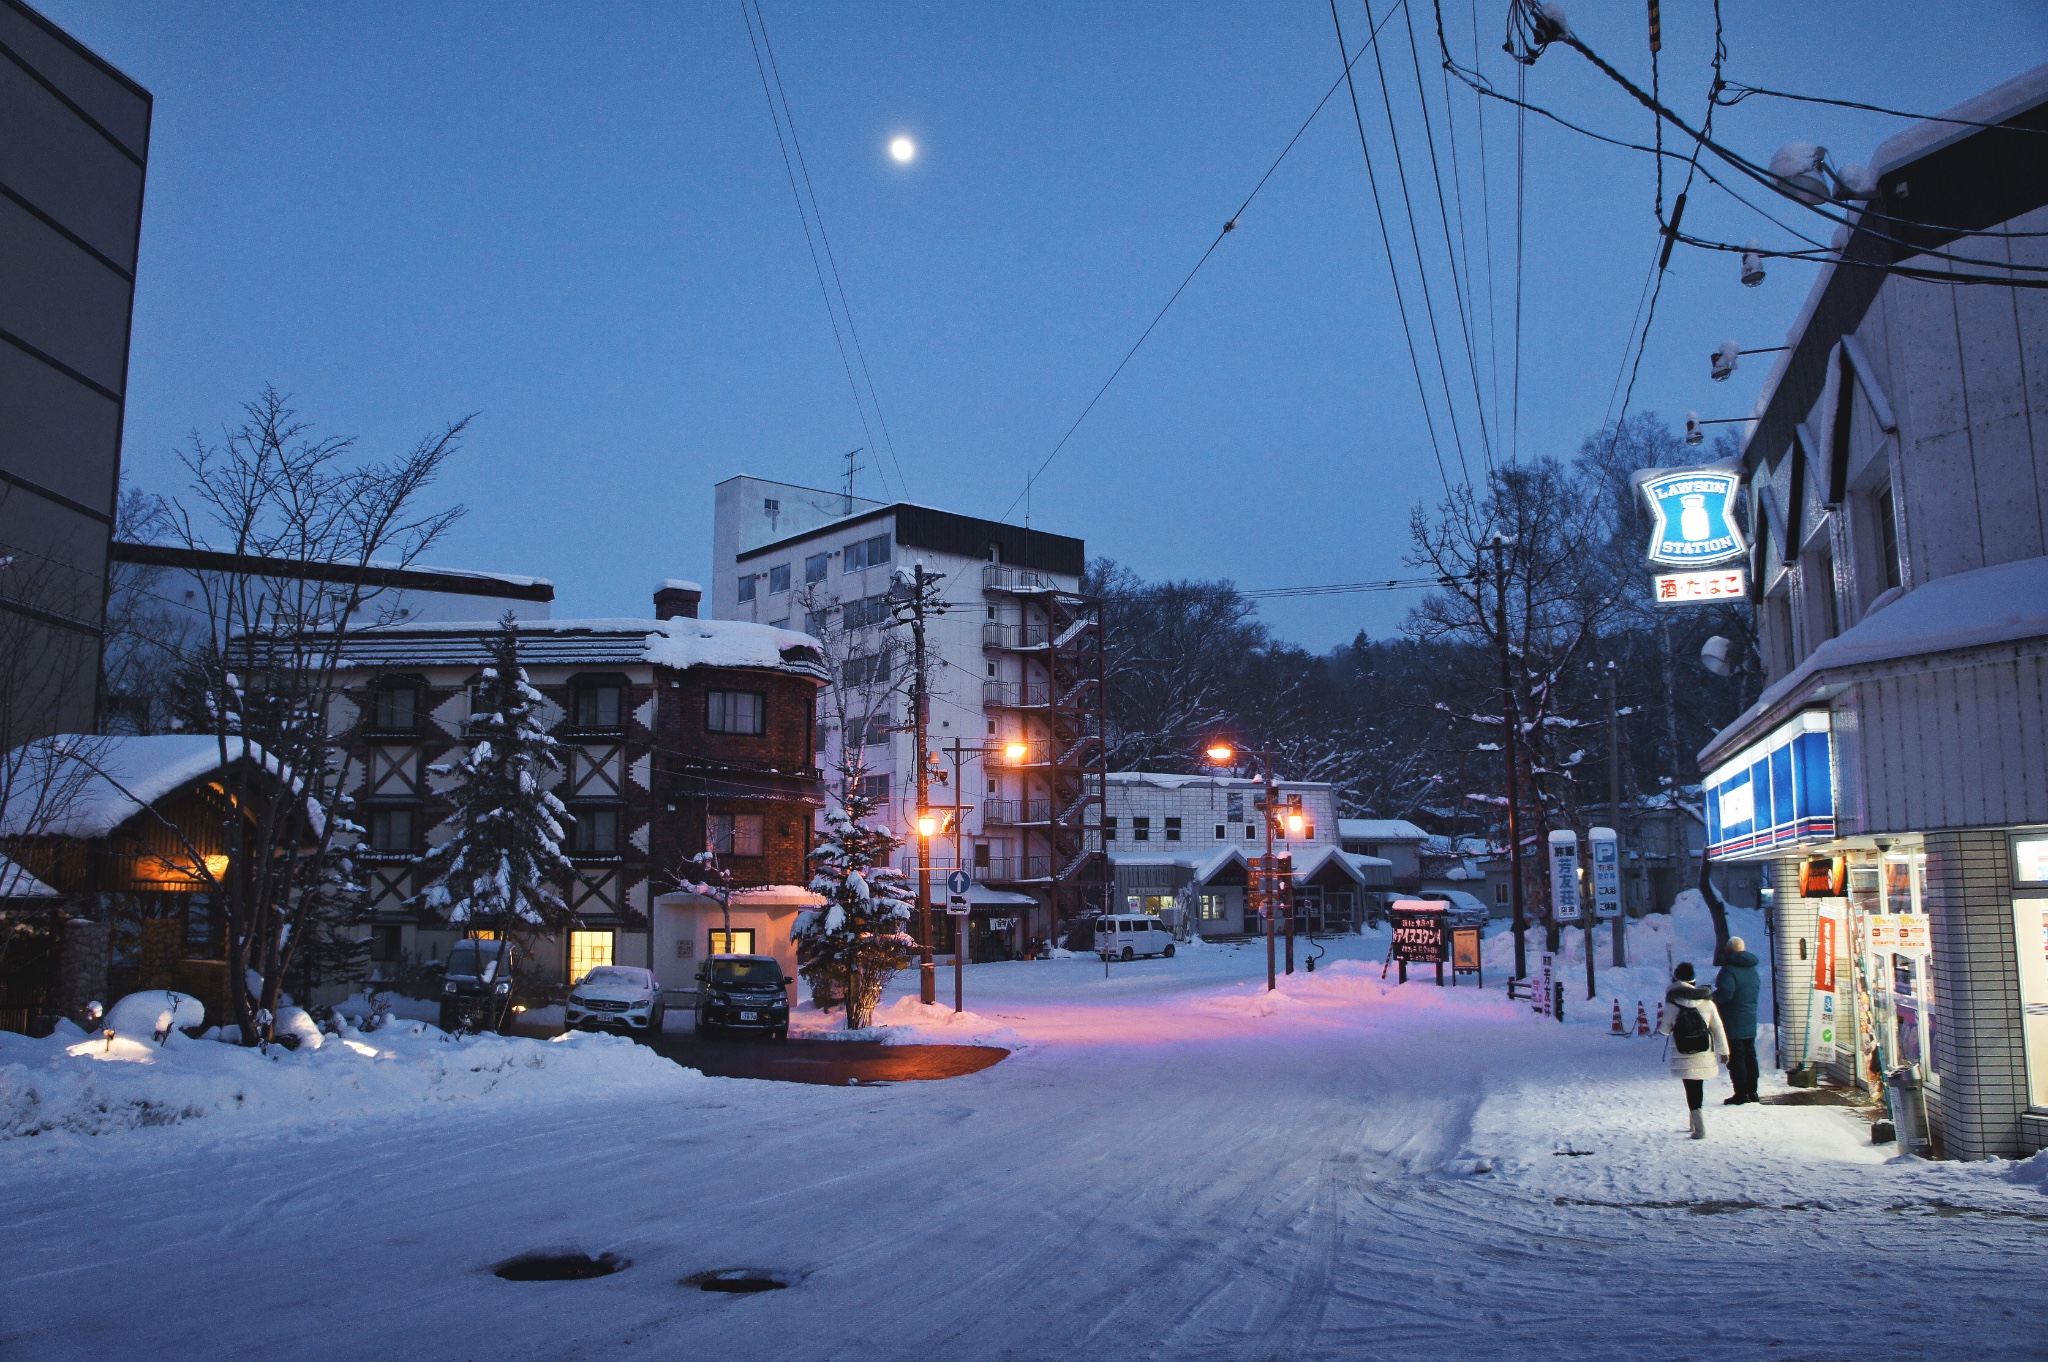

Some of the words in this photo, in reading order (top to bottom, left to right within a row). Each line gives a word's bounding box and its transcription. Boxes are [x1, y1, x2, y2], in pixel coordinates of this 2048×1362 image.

[1656, 481, 1726, 499] LAWSON
[1662, 537, 1732, 554] STATION
[1597, 844, 1613, 861] P
[1558, 859, 1573, 904] 芳友荘
